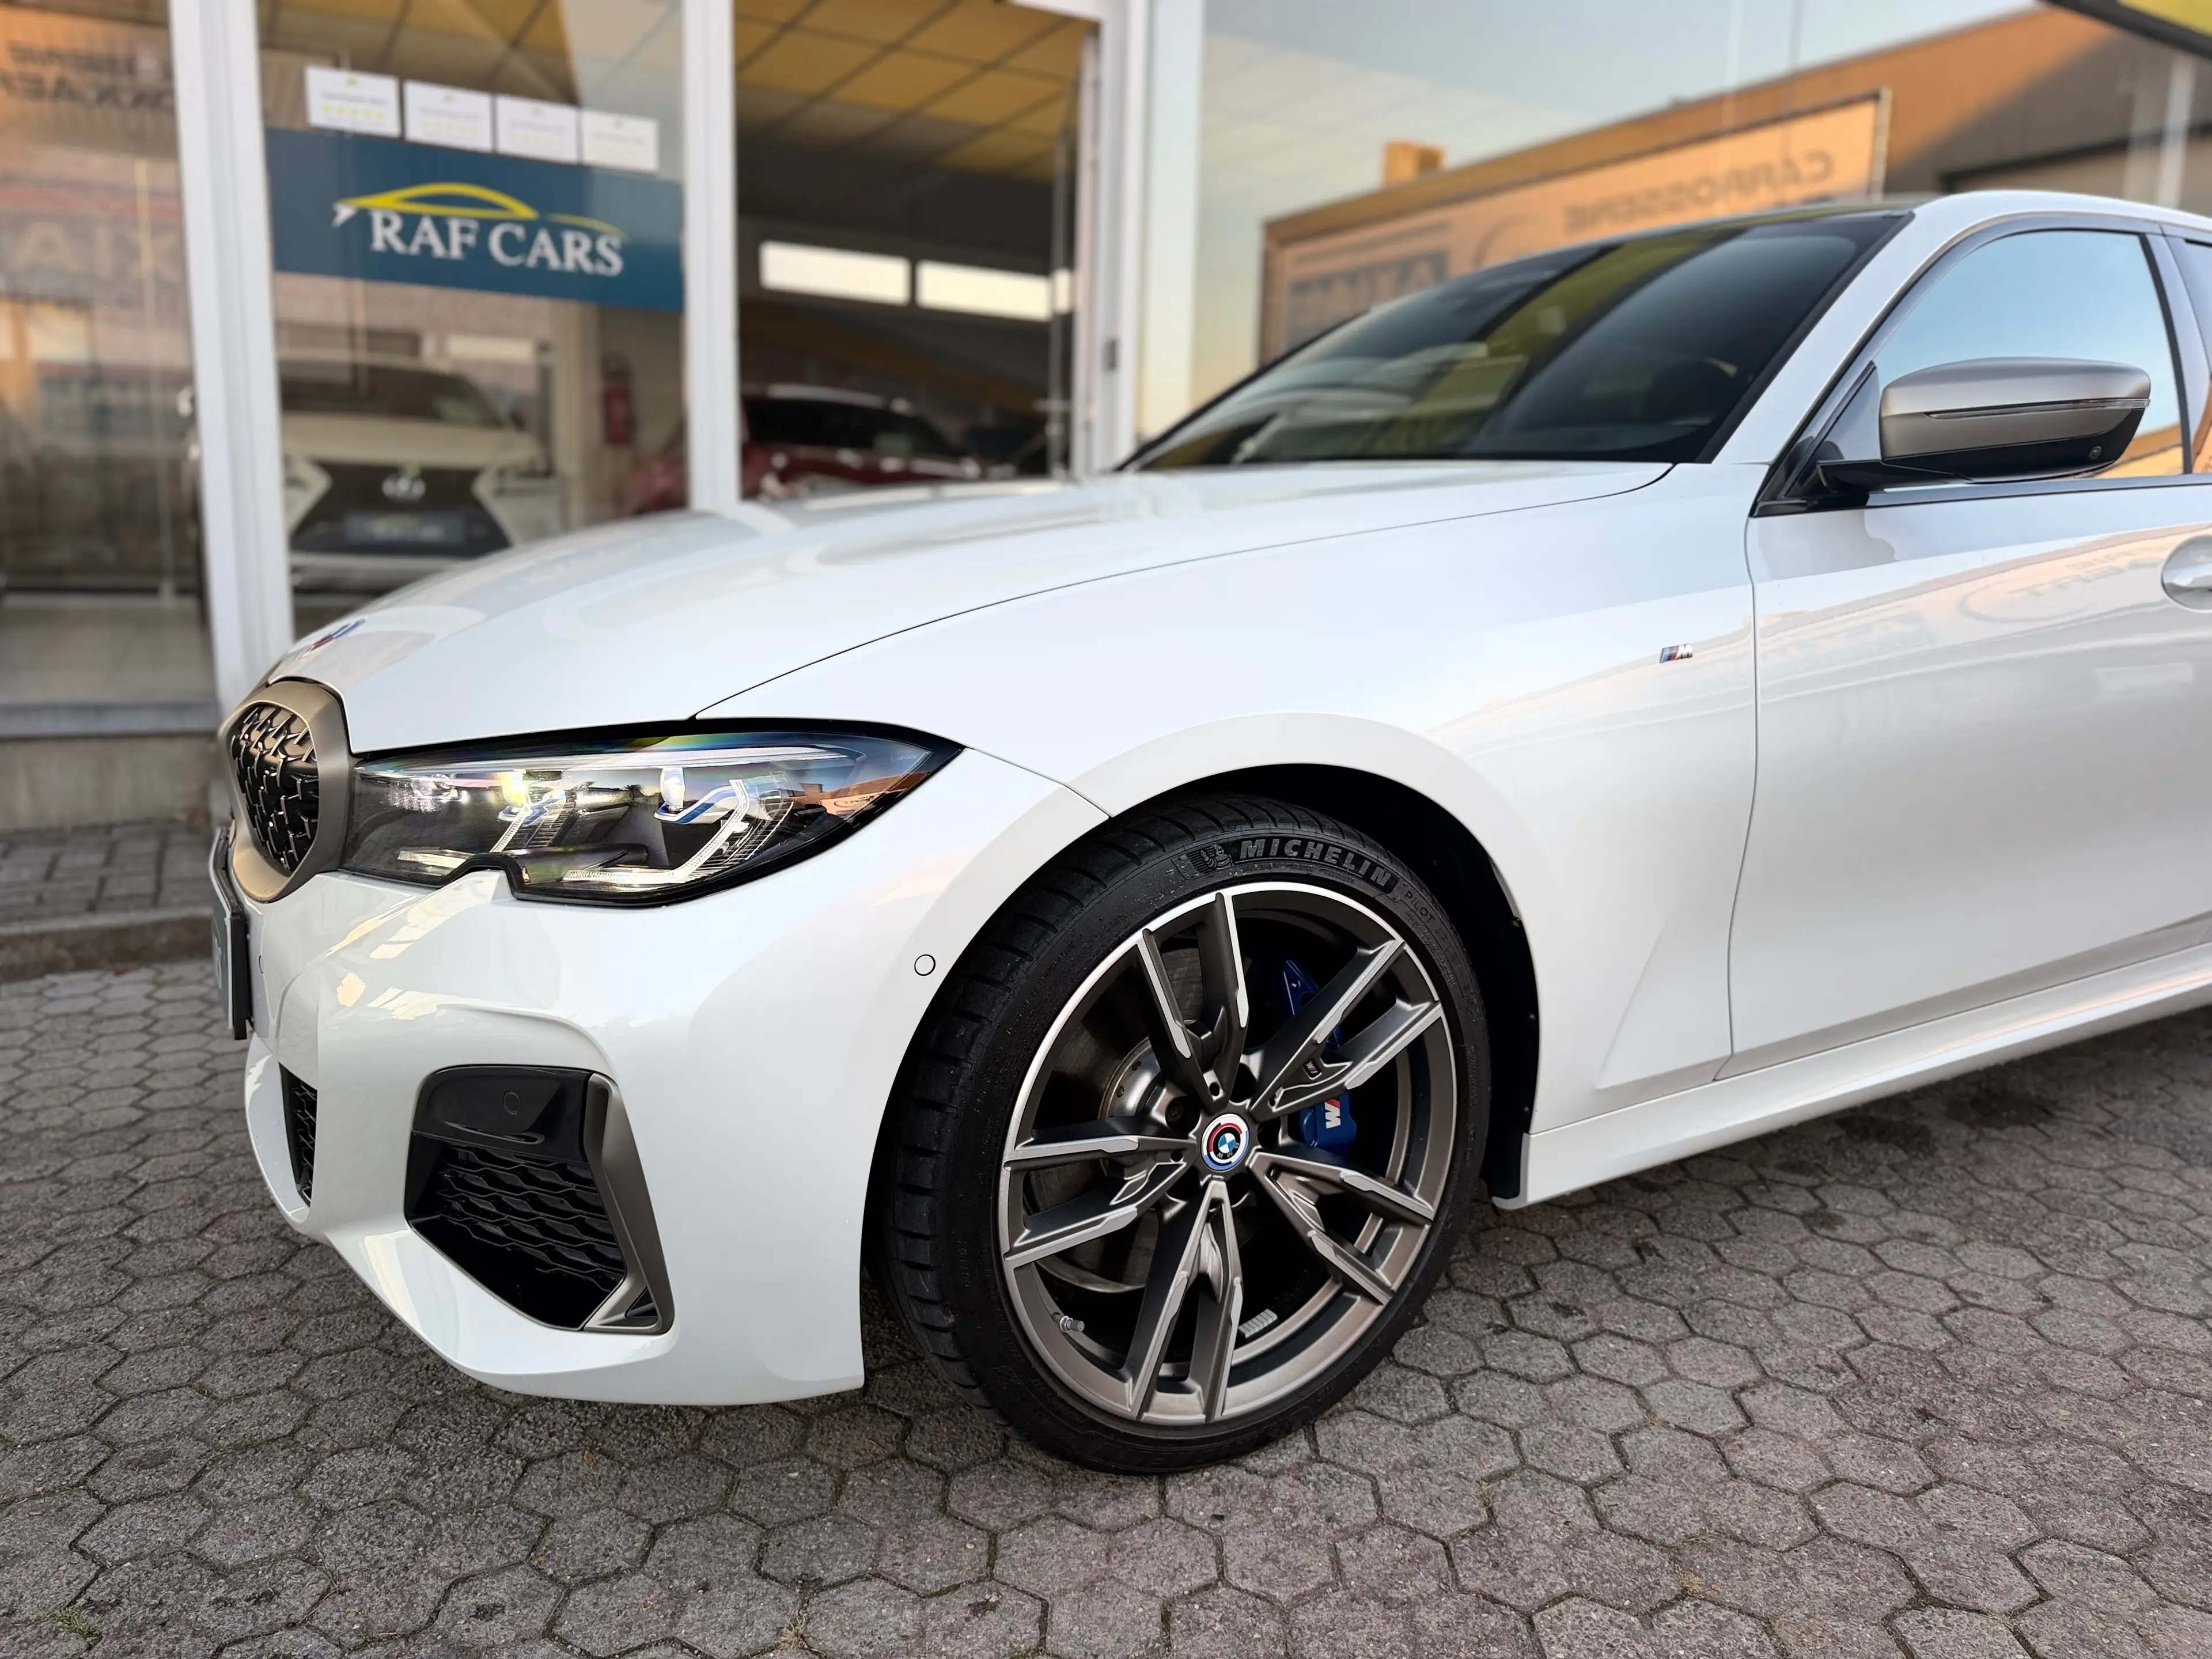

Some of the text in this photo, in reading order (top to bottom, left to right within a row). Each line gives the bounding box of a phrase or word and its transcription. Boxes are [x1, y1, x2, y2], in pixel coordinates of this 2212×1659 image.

[369, 208, 624, 278] RAF CARS
[1240, 839, 1391, 886] MICHELIN
[1404, 891, 1435, 922] PILOT
[1325, 1099, 1341, 1129] M
